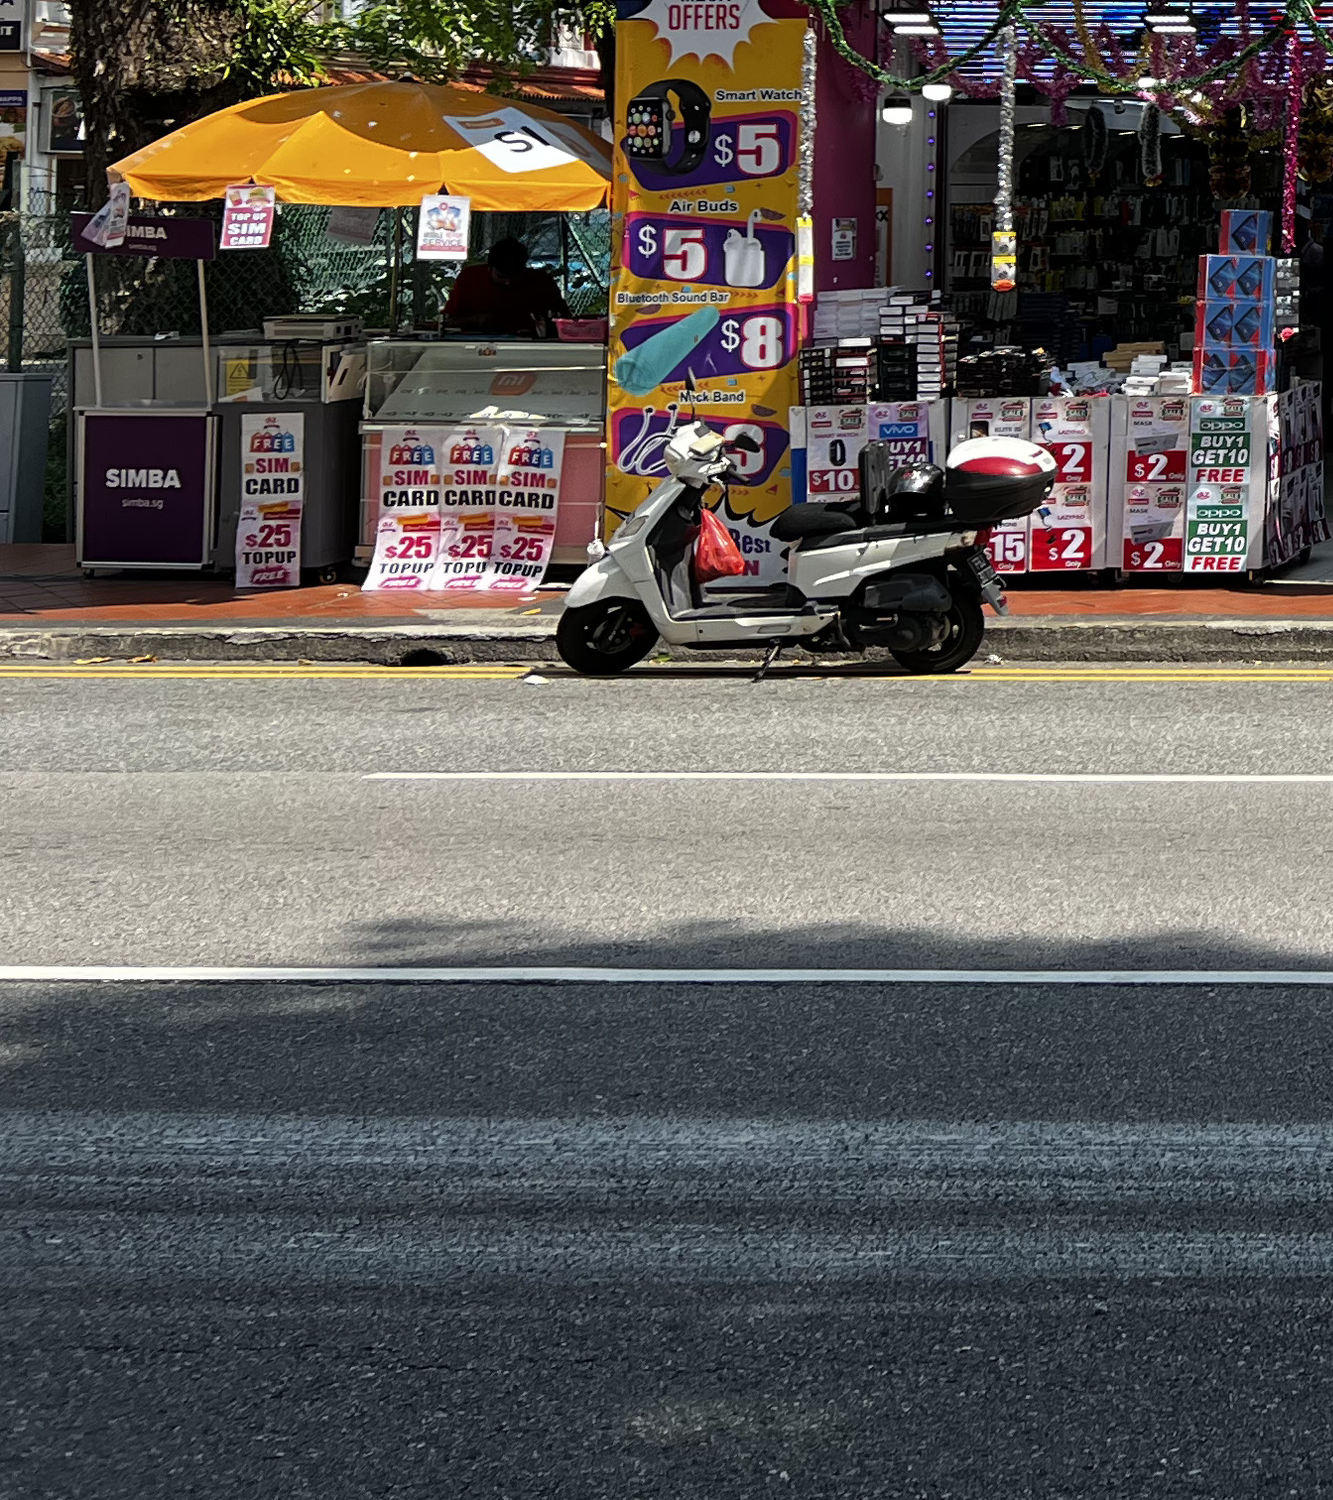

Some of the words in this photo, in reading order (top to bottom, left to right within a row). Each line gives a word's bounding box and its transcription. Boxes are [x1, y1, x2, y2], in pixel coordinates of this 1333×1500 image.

[668, 5, 741, 31] OFFERS
[716, 90, 756, 101] Smart
[760, 88, 801, 100] Watch
[714, 124, 780, 175] $5
[669, 200, 693, 212] Air
[698, 200, 737, 212] Buds
[127, 226, 168, 239] IMBA
[228, 223, 267, 235] SIM
[229, 235, 263, 246] CARD
[638, 224, 708, 280] $5
[617, 294, 669, 304] Bluetooth
[672, 293, 707, 303] Sound
[710, 292, 729, 302] Bar
[720, 316, 783, 369] $8
[713, 391, 744, 402] Band
[883, 425, 915, 435] vivo
[1201, 420, 1244, 431] oppo
[252, 438, 293, 450] FREE
[1199, 435, 1244, 448] BUY1
[392, 449, 433, 462] FREE
[454, 448, 491, 462] FREE
[511, 451, 551, 466] FREE
[1191, 450, 1249, 465] GET10
[256, 457, 289, 474] SIM
[1134, 454, 1169, 481] $2
[105, 468, 181, 490] SIMBA
[394, 469, 429, 486] SIM
[454, 469, 488, 485] SIM
[511, 471, 546, 488] SIM
[812, 470, 855, 491] $10
[1196, 468, 1245, 482] FREE
[246, 478, 299, 495] CARD
[122, 498, 164, 510] simba.sg
[383, 490, 440, 507] CARD
[499, 491, 555, 509] CARD
[1197, 508, 1241, 518] oppo
[246, 524, 292, 548] $25
[1196, 523, 1241, 535] BUY1
[385, 536, 433, 559] $25
[448, 535, 493, 560] $25
[500, 537, 544, 561] $25
[1049, 529, 1086, 561] $2
[1188, 537, 1246, 552] GET10
[243, 551, 297, 565] TOPUP
[1130, 541, 1165, 569] $2
[493, 561, 543, 578] TOPUP
[1192, 556, 1241, 570] FREE
